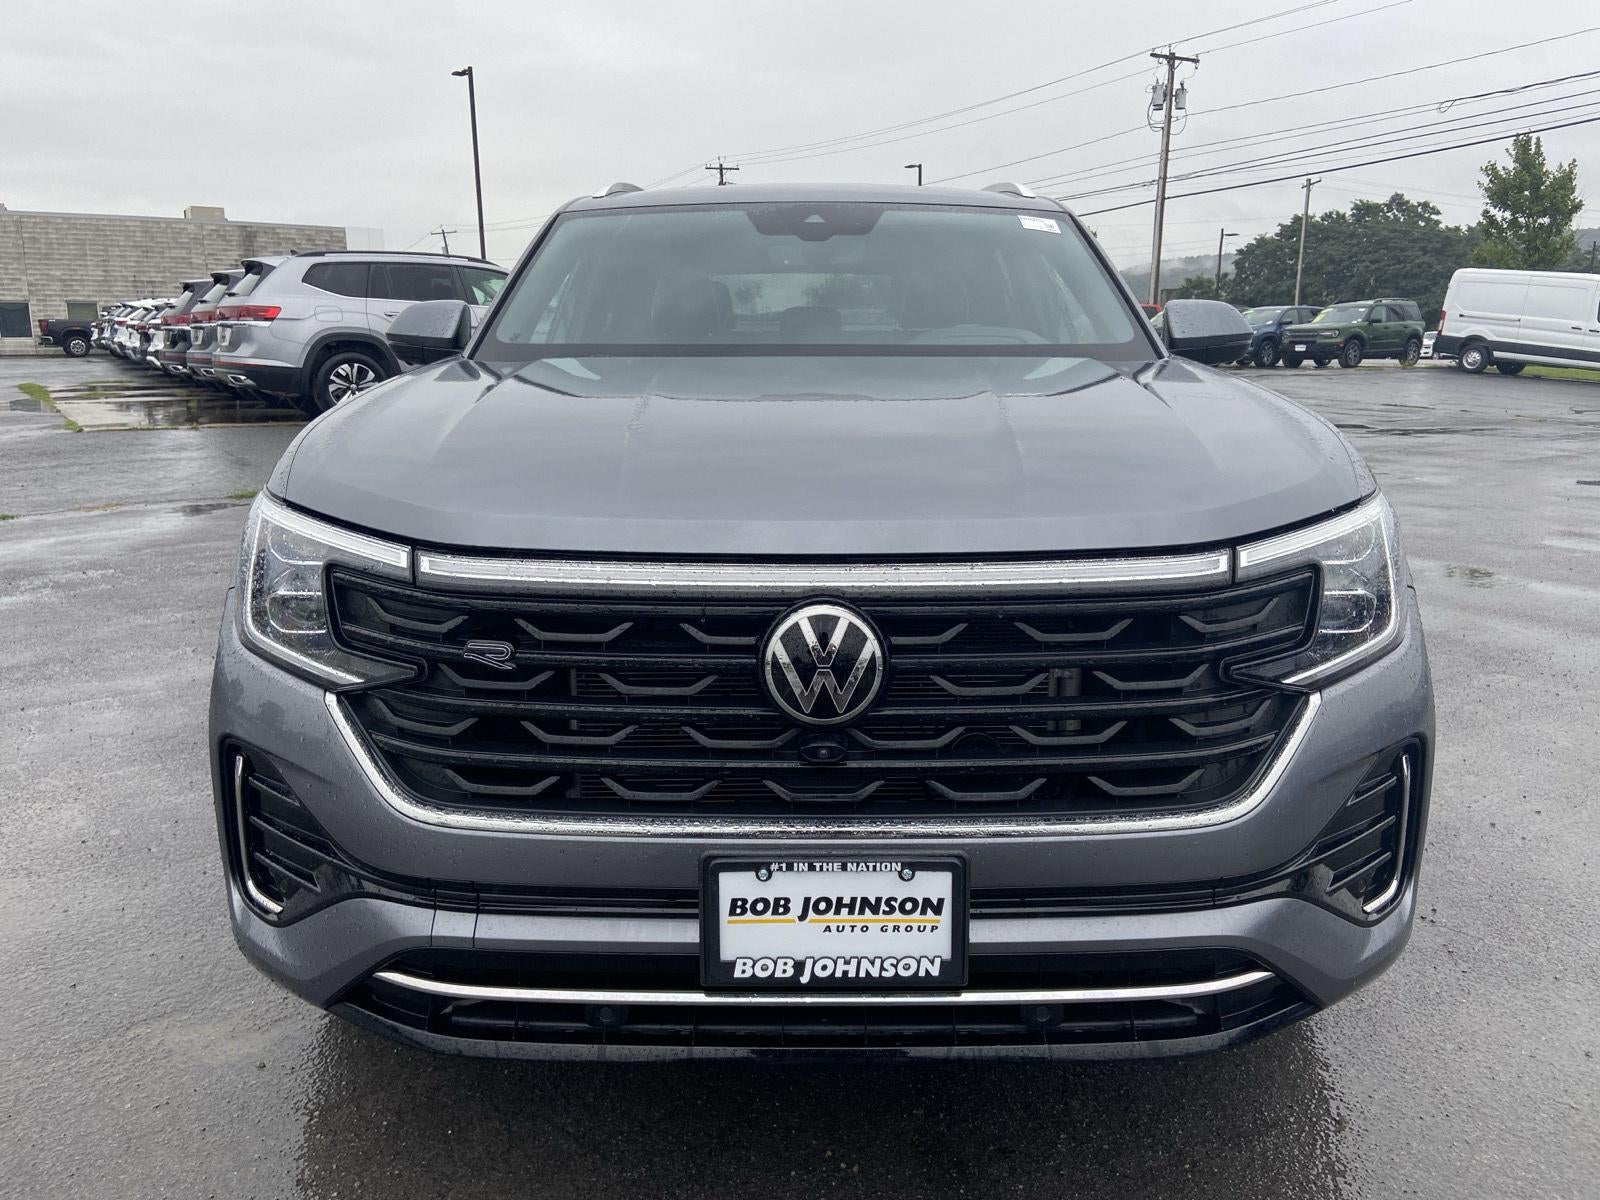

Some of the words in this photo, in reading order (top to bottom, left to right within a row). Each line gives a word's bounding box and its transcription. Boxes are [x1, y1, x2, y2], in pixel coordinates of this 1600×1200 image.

[770, 862, 787, 872] #1
[793, 862, 809, 872] IN
[814, 862, 842, 872] THE
[847, 862, 902, 872] NATION
[728, 897, 791, 917] BOB
[797, 896, 945, 922] JOHNSON
[822, 925, 869, 933] AUTO
[880, 925, 939, 933] GROUP
[733, 957, 795, 978] BOB
[800, 957, 942, 984] JOHNSON
